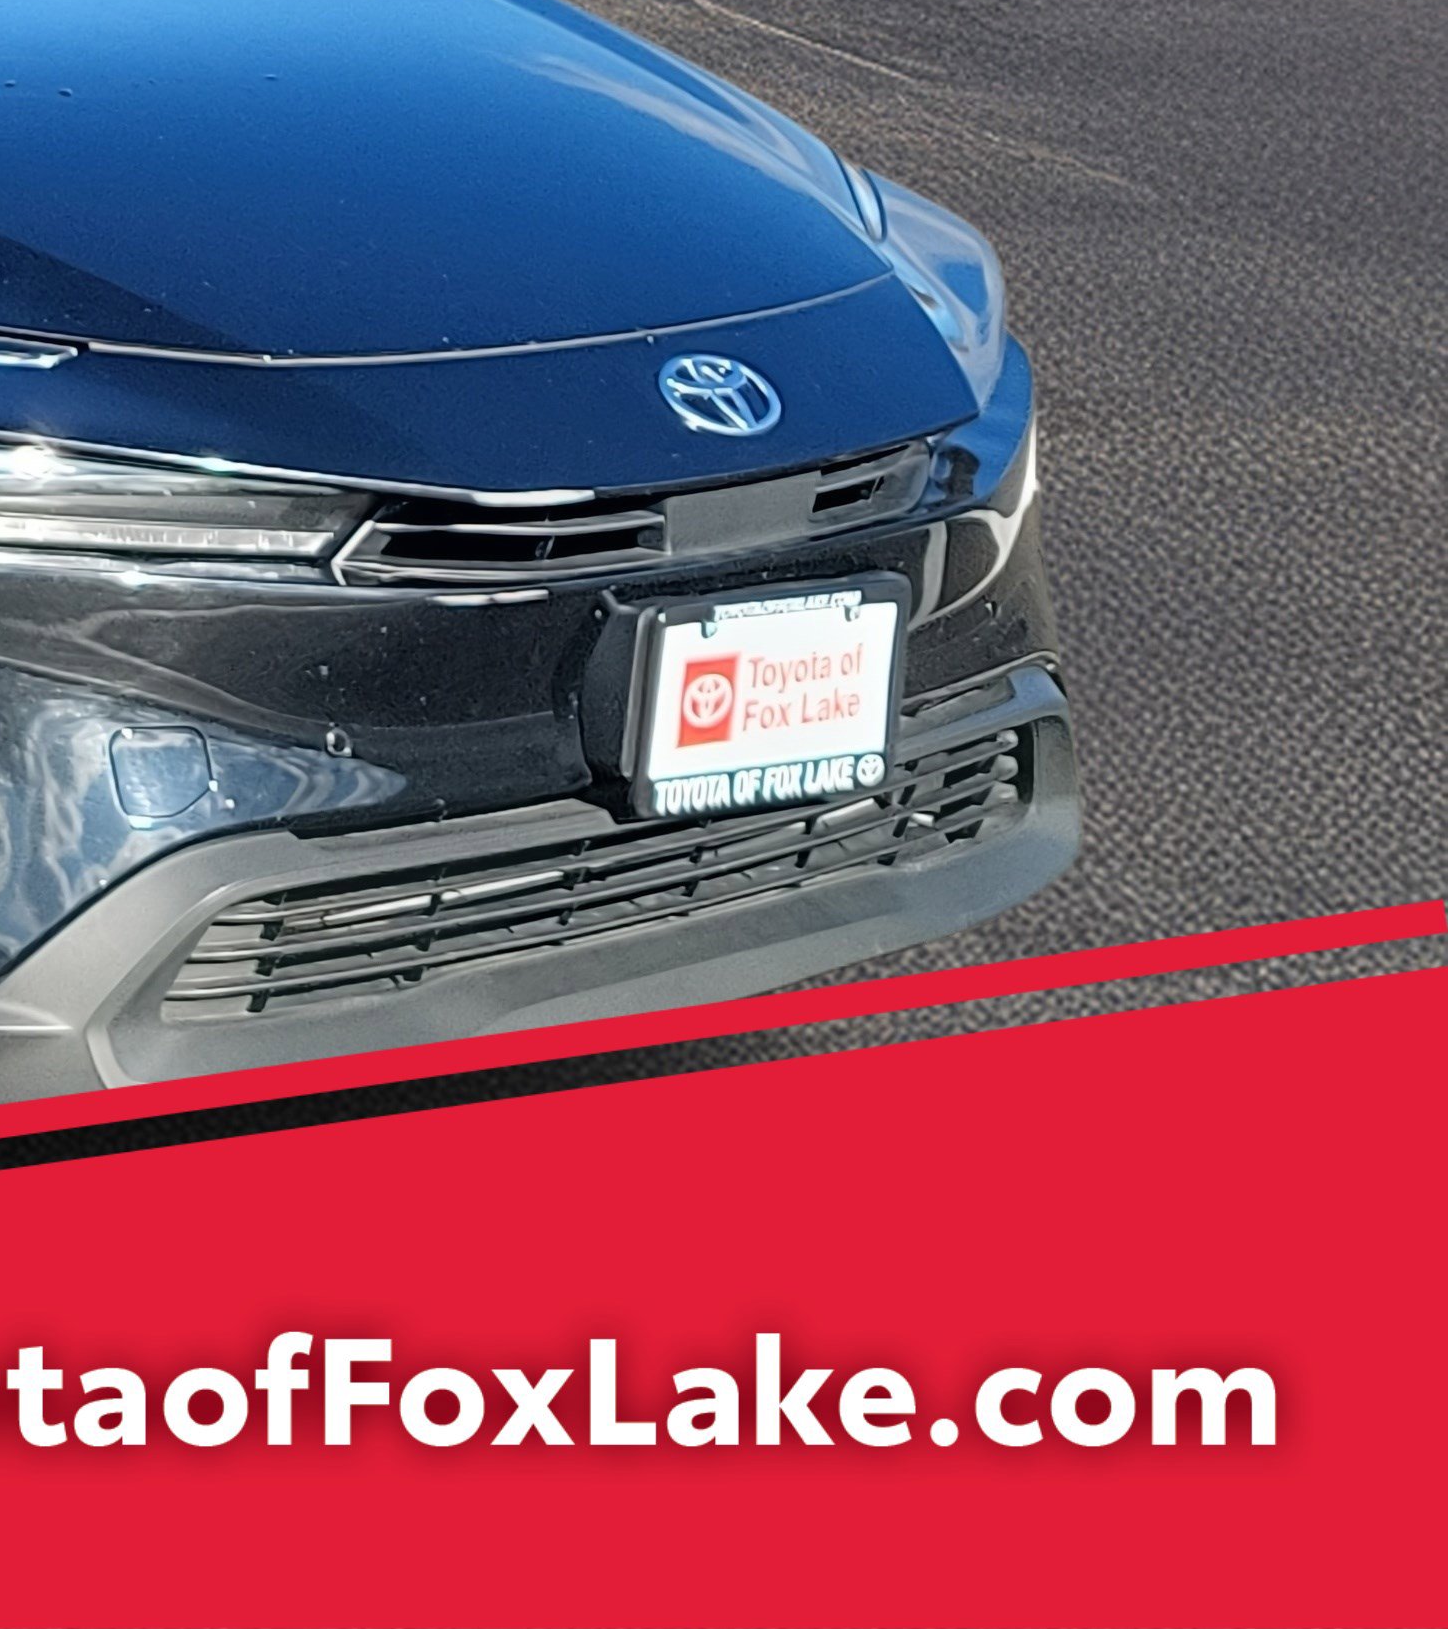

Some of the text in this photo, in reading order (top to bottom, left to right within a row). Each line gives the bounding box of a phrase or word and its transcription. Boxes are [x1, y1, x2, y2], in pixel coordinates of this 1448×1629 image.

[748, 642, 864, 694] Toyota of
[742, 686, 861, 732] Fox Lake
[654, 754, 856, 817] TOYOTA OF FOX LAKE
